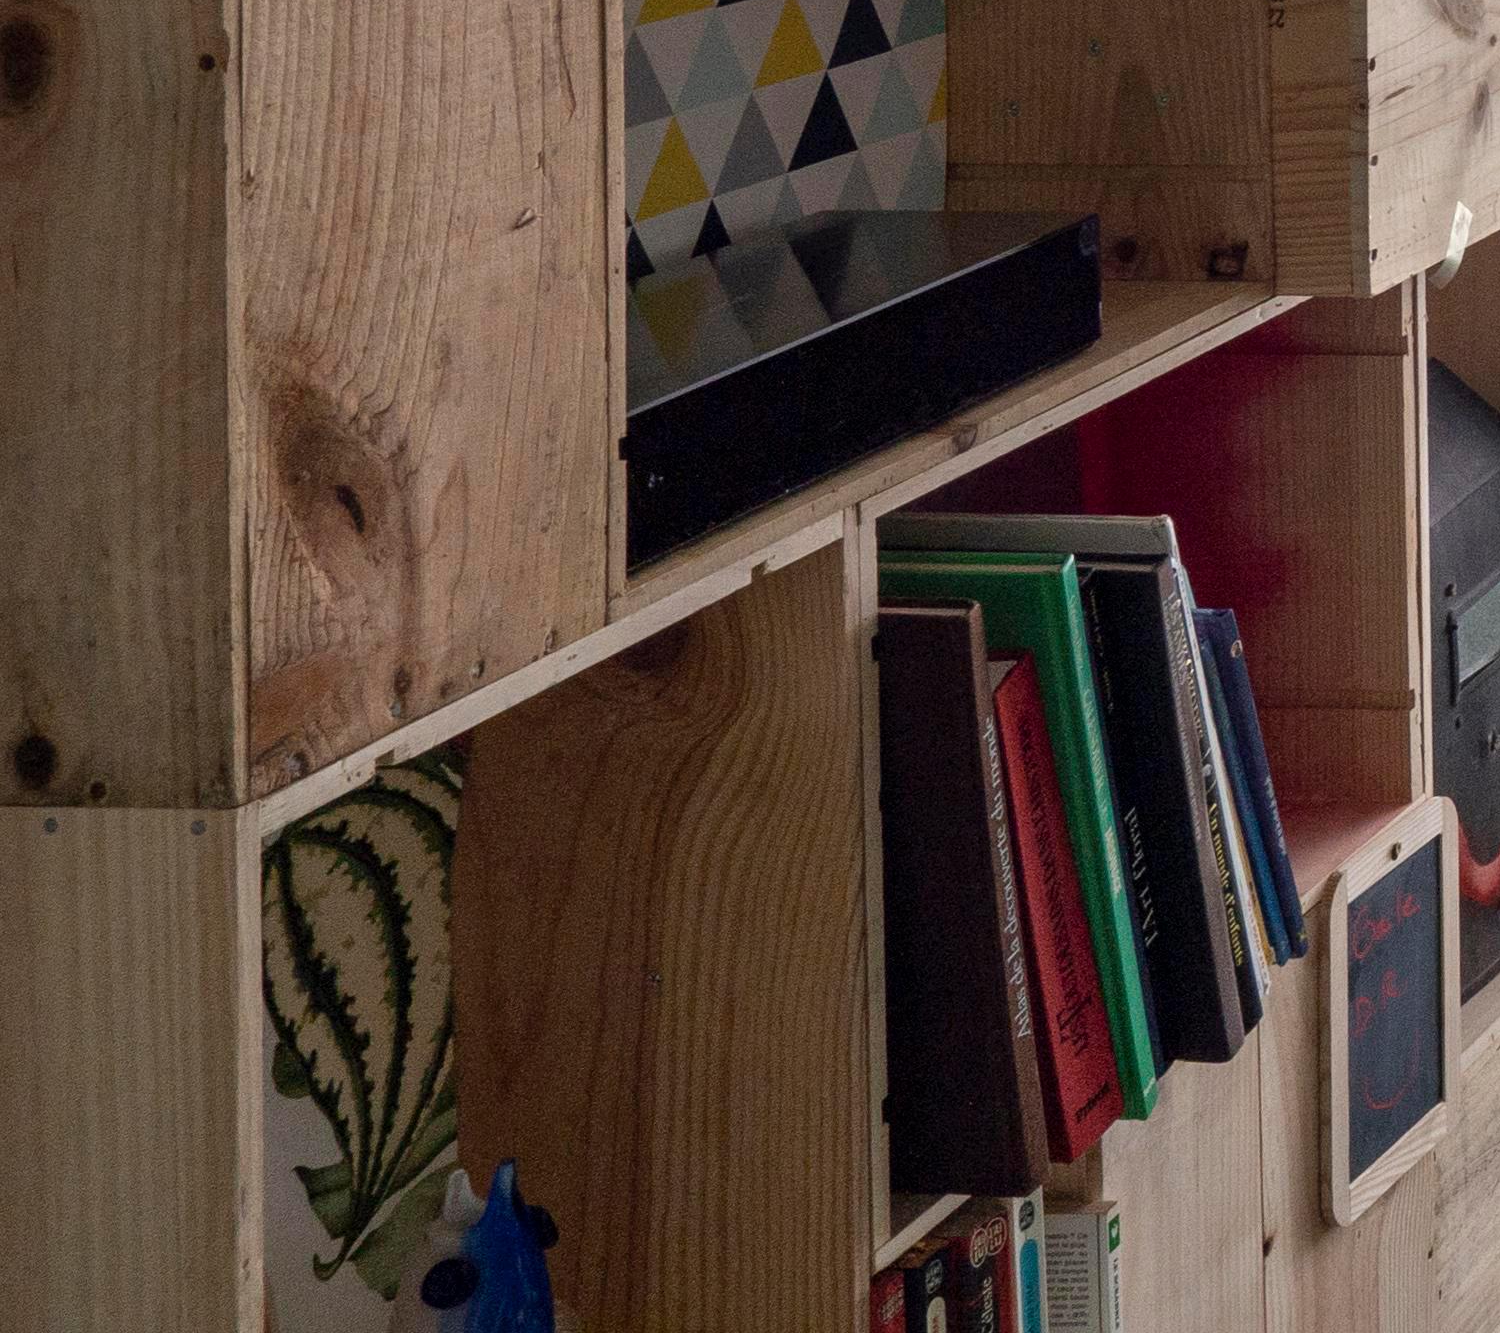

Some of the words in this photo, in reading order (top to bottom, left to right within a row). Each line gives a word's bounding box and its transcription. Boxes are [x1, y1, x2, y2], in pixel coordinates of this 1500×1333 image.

[981, 719, 1001, 794] monde
[989, 795, 1004, 819] du
[1209, 832, 1231, 890] monde
[1221, 891, 1246, 968] d'enfants
[1007, 937, 1021, 960] la
[1009, 959, 1024, 985] de
[1014, 986, 1033, 1039] Atlas
